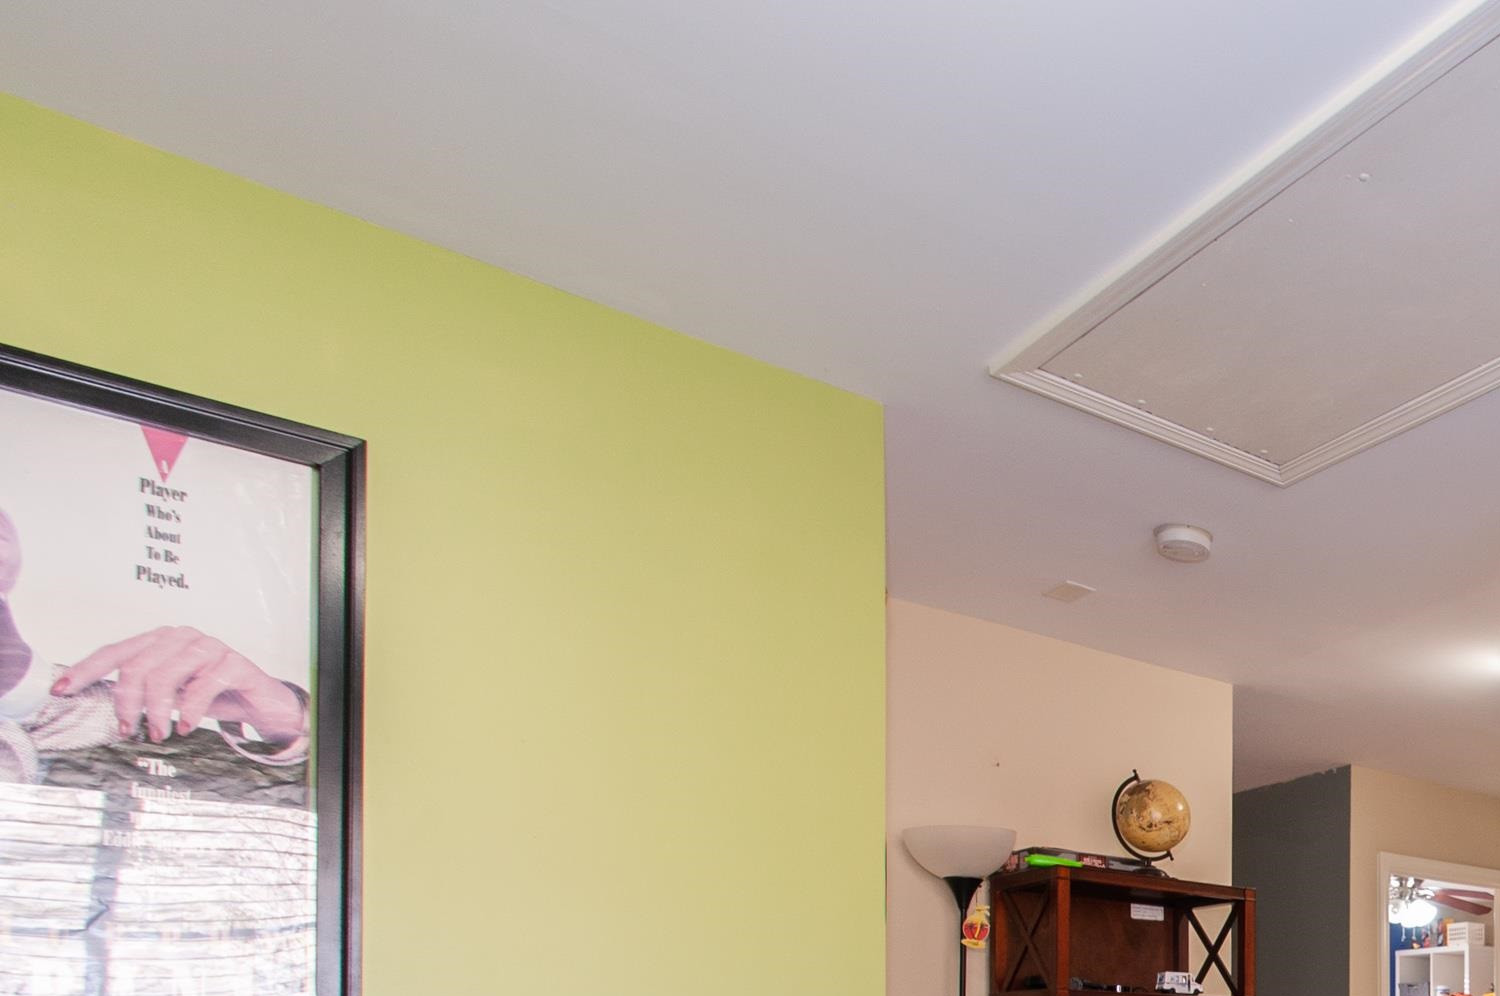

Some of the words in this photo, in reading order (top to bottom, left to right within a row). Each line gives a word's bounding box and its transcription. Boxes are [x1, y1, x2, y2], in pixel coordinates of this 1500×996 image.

[138, 476, 188, 502] Player
[144, 503, 182, 523] Who's
[145, 525, 182, 544] About
[145, 545, 161, 560] To
[163, 549, 180, 564] Be
[135, 564, 189, 590] Played.
